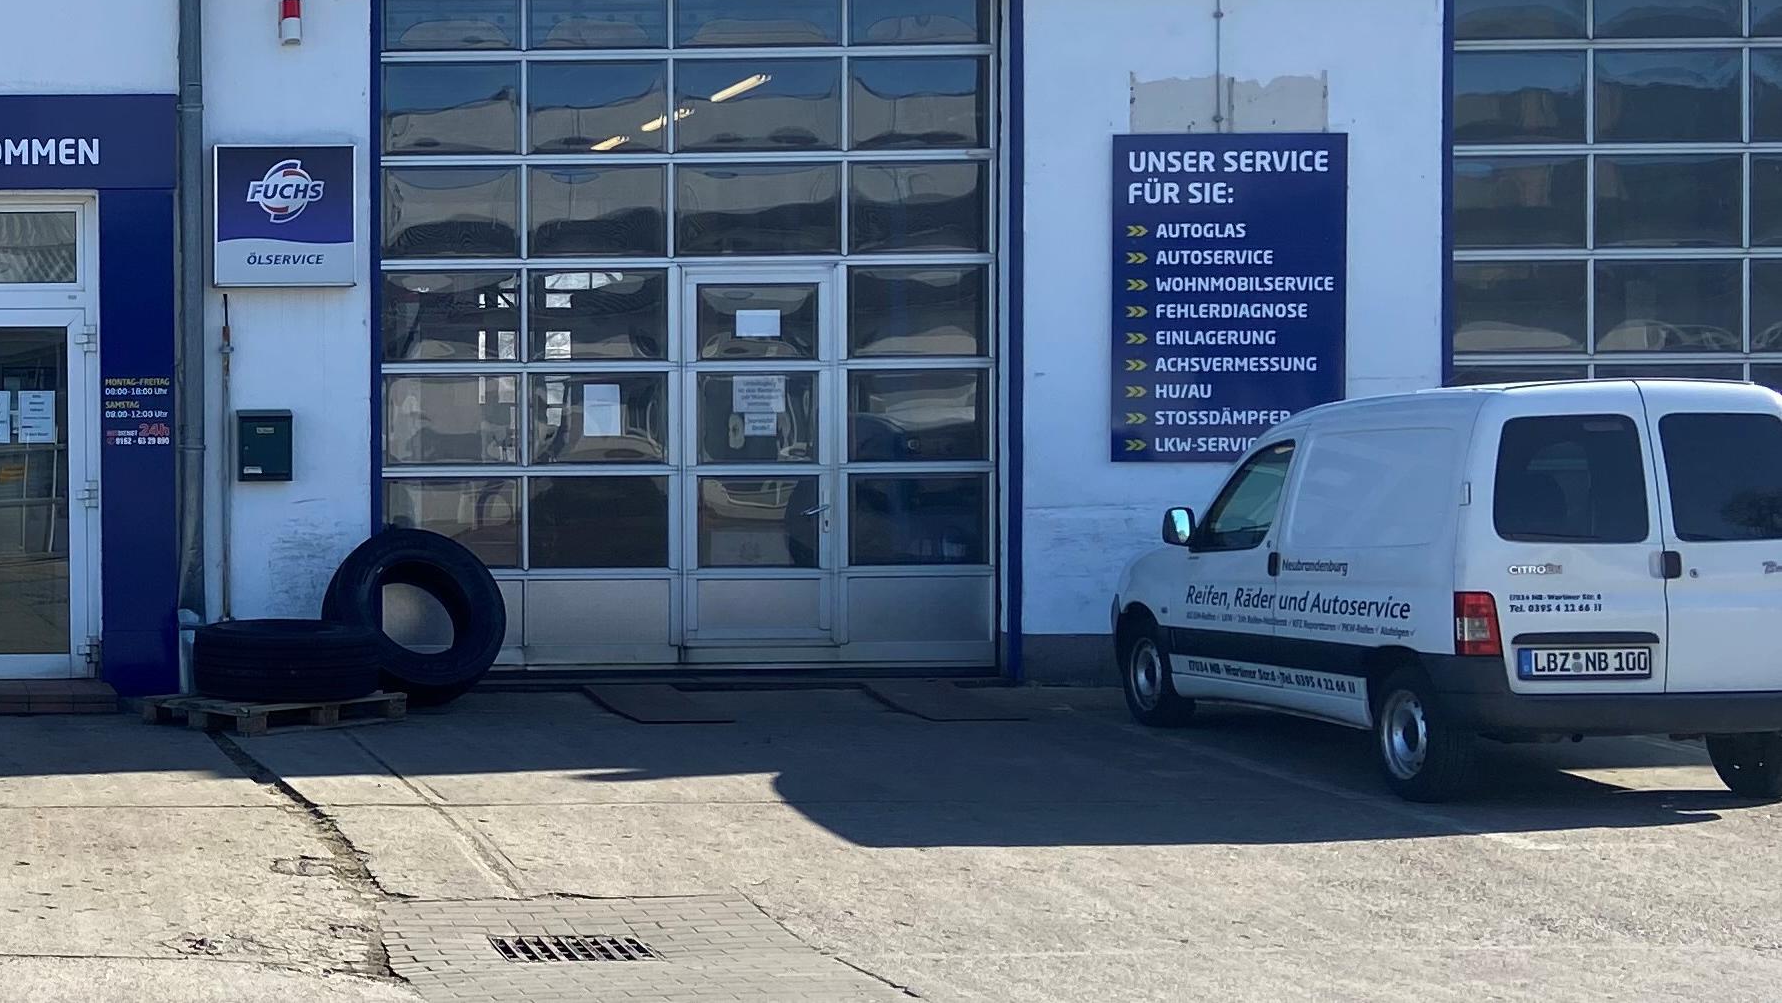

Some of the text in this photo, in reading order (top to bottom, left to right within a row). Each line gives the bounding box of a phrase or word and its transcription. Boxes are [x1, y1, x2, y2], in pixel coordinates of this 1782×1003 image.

[1128, 150, 1329, 173] UNSER SERVICE
[249, 182, 324, 200] FUCHS
[1128, 177, 1234, 204] FÜR SIE:
[1155, 223, 1247, 238] AUTOGLAS
[246, 251, 325, 266] ÖLSERVICE
[1155, 249, 1274, 265] AUTOSERVICE
[1155, 276, 1335, 291] WOHNMOBILSERVICE
[1155, 303, 1308, 318] FEHLERDIAGNOSE
[1155, 330, 1277, 345] EINLAGERUNG
[1155, 357, 1318, 372] ACHSVERMESSUNG
[1154, 384, 1212, 398] HU/AU
[1154, 437, 1258, 452] LKW-SERVIC
[1282, 558, 1348, 576] Neubrandenburg
[1185, 584, 1411, 619] Reifen, Räder und Autoservice
[1510, 604, 1525, 612] Tel.
[1534, 651, 1648, 673] LBZ NB 100
